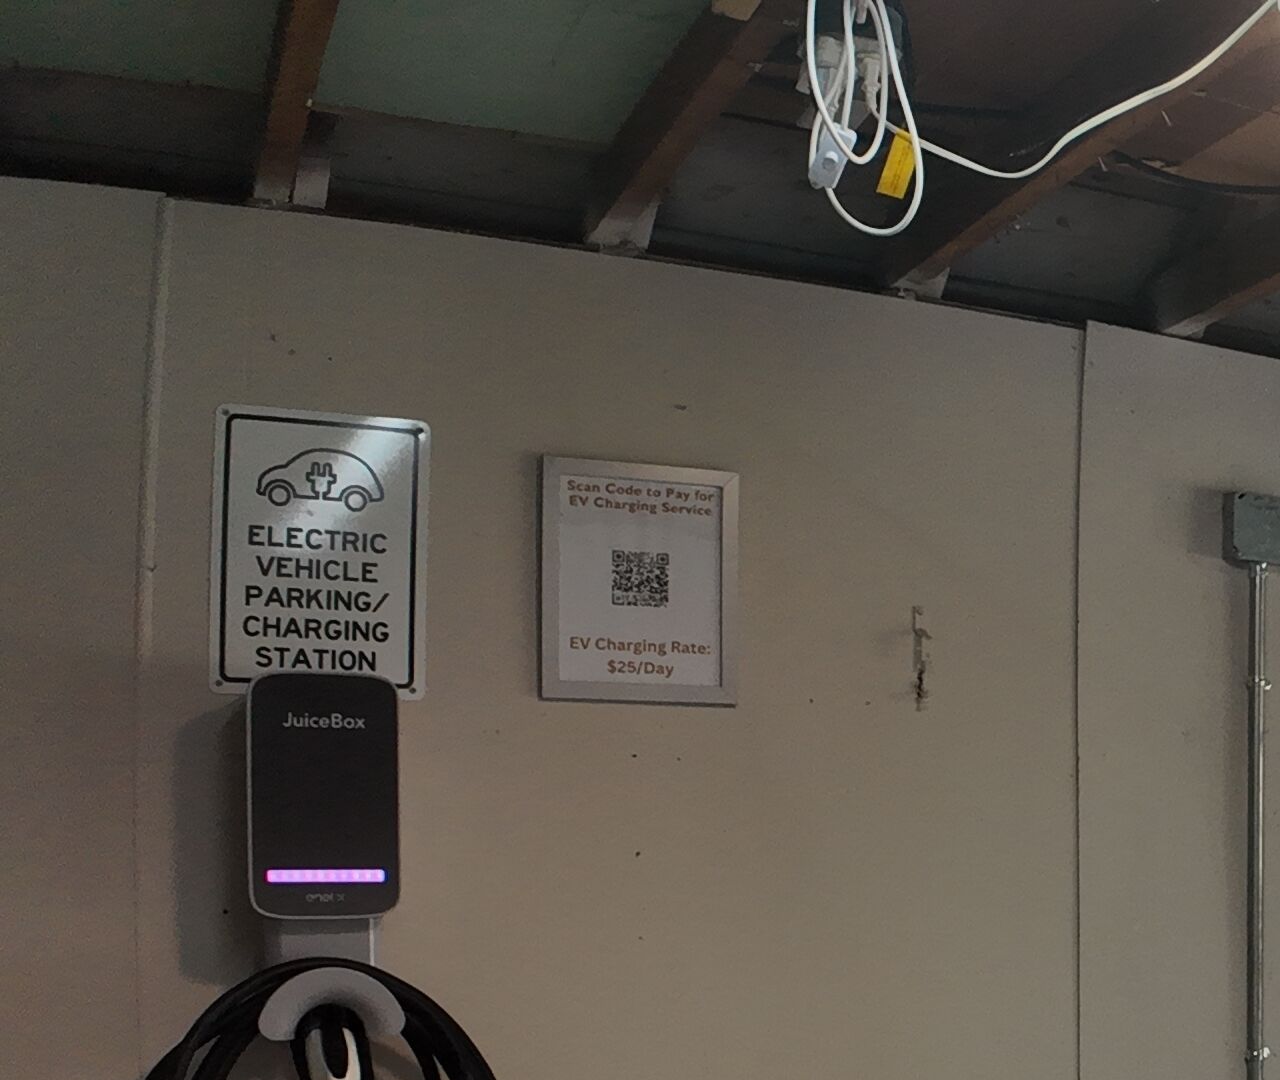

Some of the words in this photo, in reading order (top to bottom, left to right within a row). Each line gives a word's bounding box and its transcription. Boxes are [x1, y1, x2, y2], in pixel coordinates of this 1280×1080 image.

[568, 480, 600, 493] Scan
[605, 483, 641, 496] Code
[646, 488, 661, 498] to
[666, 488, 689, 502] Pay
[695, 489, 714, 502] for
[569, 496, 589, 507] EV
[594, 497, 657, 514] Charging
[662, 503, 712, 516] Service
[248, 525, 387, 553] ELECTRIC
[256, 556, 378, 583] VEHICLE
[245, 586, 390, 612] PARKING/
[242, 616, 389, 642] CHARGING
[570, 637, 591, 650] EV
[595, 638, 667, 655] Charging
[671, 641, 711, 654] Rate:
[255, 647, 377, 671] STATION
[608, 661, 673, 677] $25/Day
[282, 712, 366, 729] JuiceBox
